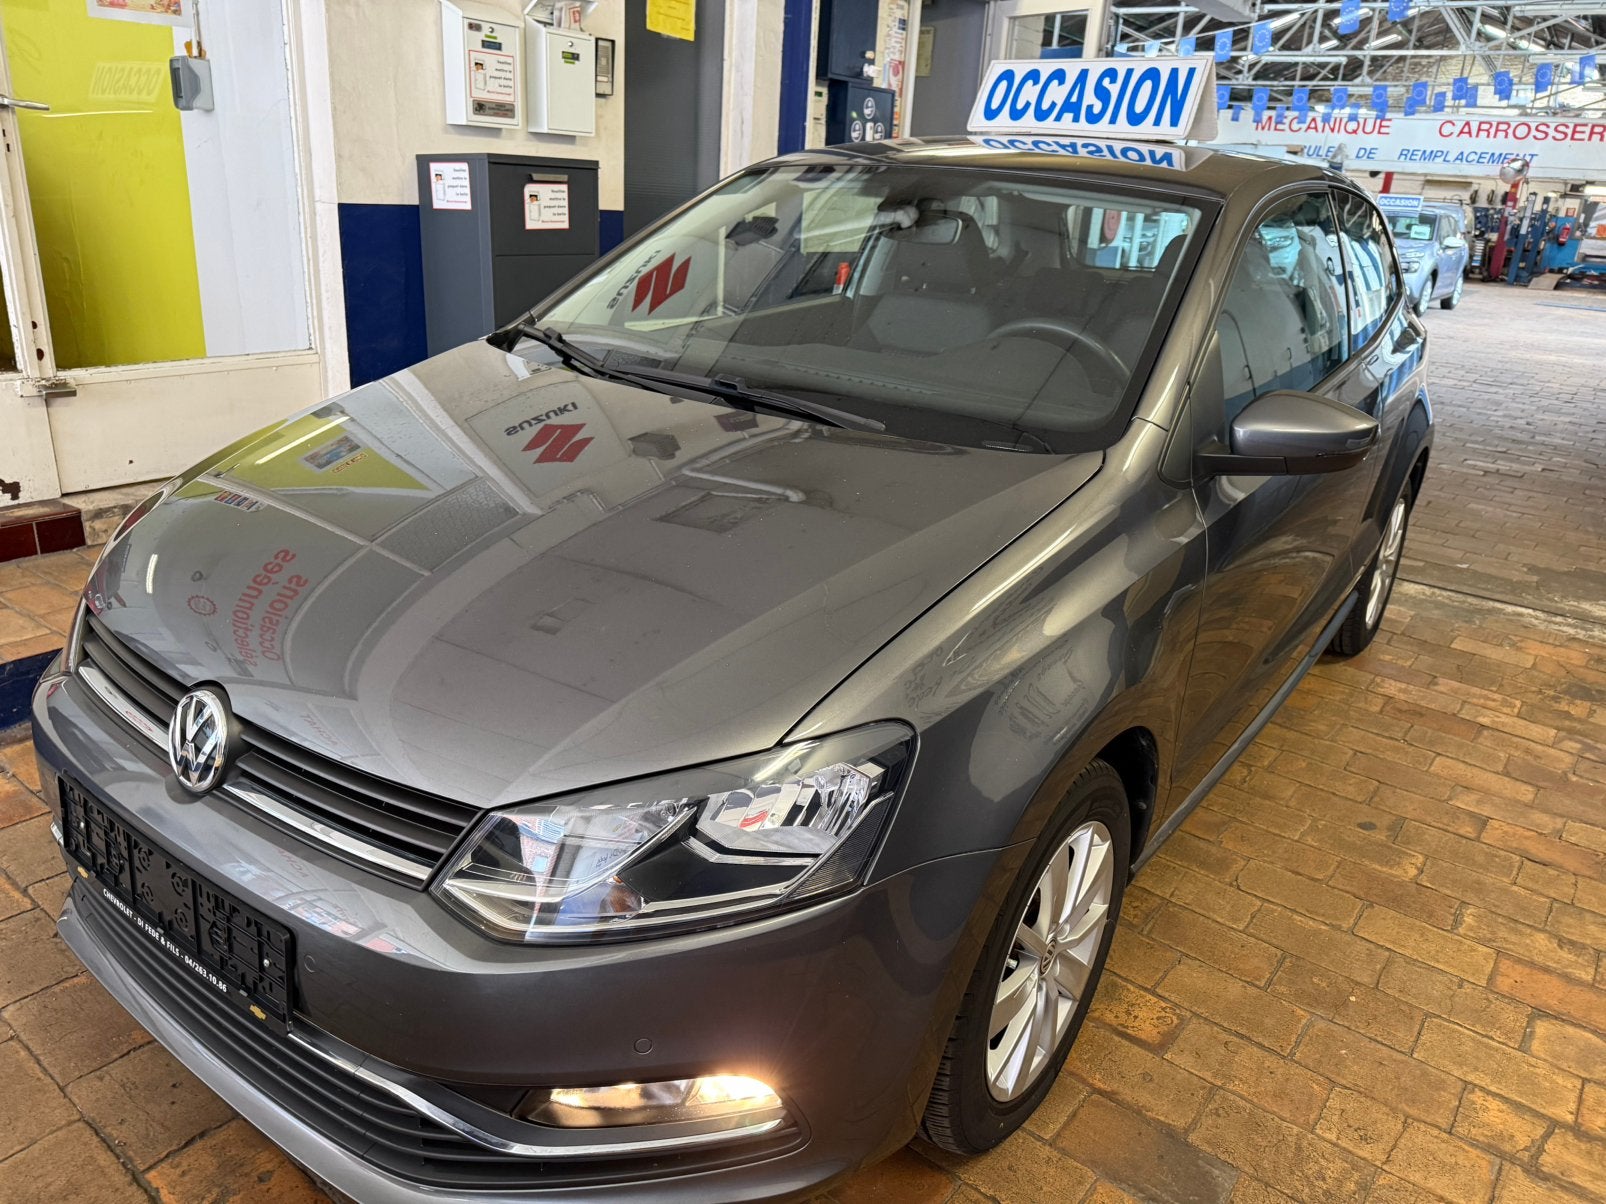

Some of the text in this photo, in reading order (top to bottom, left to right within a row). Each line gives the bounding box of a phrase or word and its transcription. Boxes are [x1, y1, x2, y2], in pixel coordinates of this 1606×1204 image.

[983, 67, 1197, 128] OCCASION
[1438, 120, 1606, 143] CARROSSER
[1355, 147, 1379, 160] DE
[1379, 197, 1420, 207] OCCASION
[103, 888, 133, 919] CHEVROLET
[137, 917, 144, 928] DI
[159, 936, 166, 945] &
[166, 941, 180, 956] FILS
[184, 955, 227, 993] 04/263.10.86
